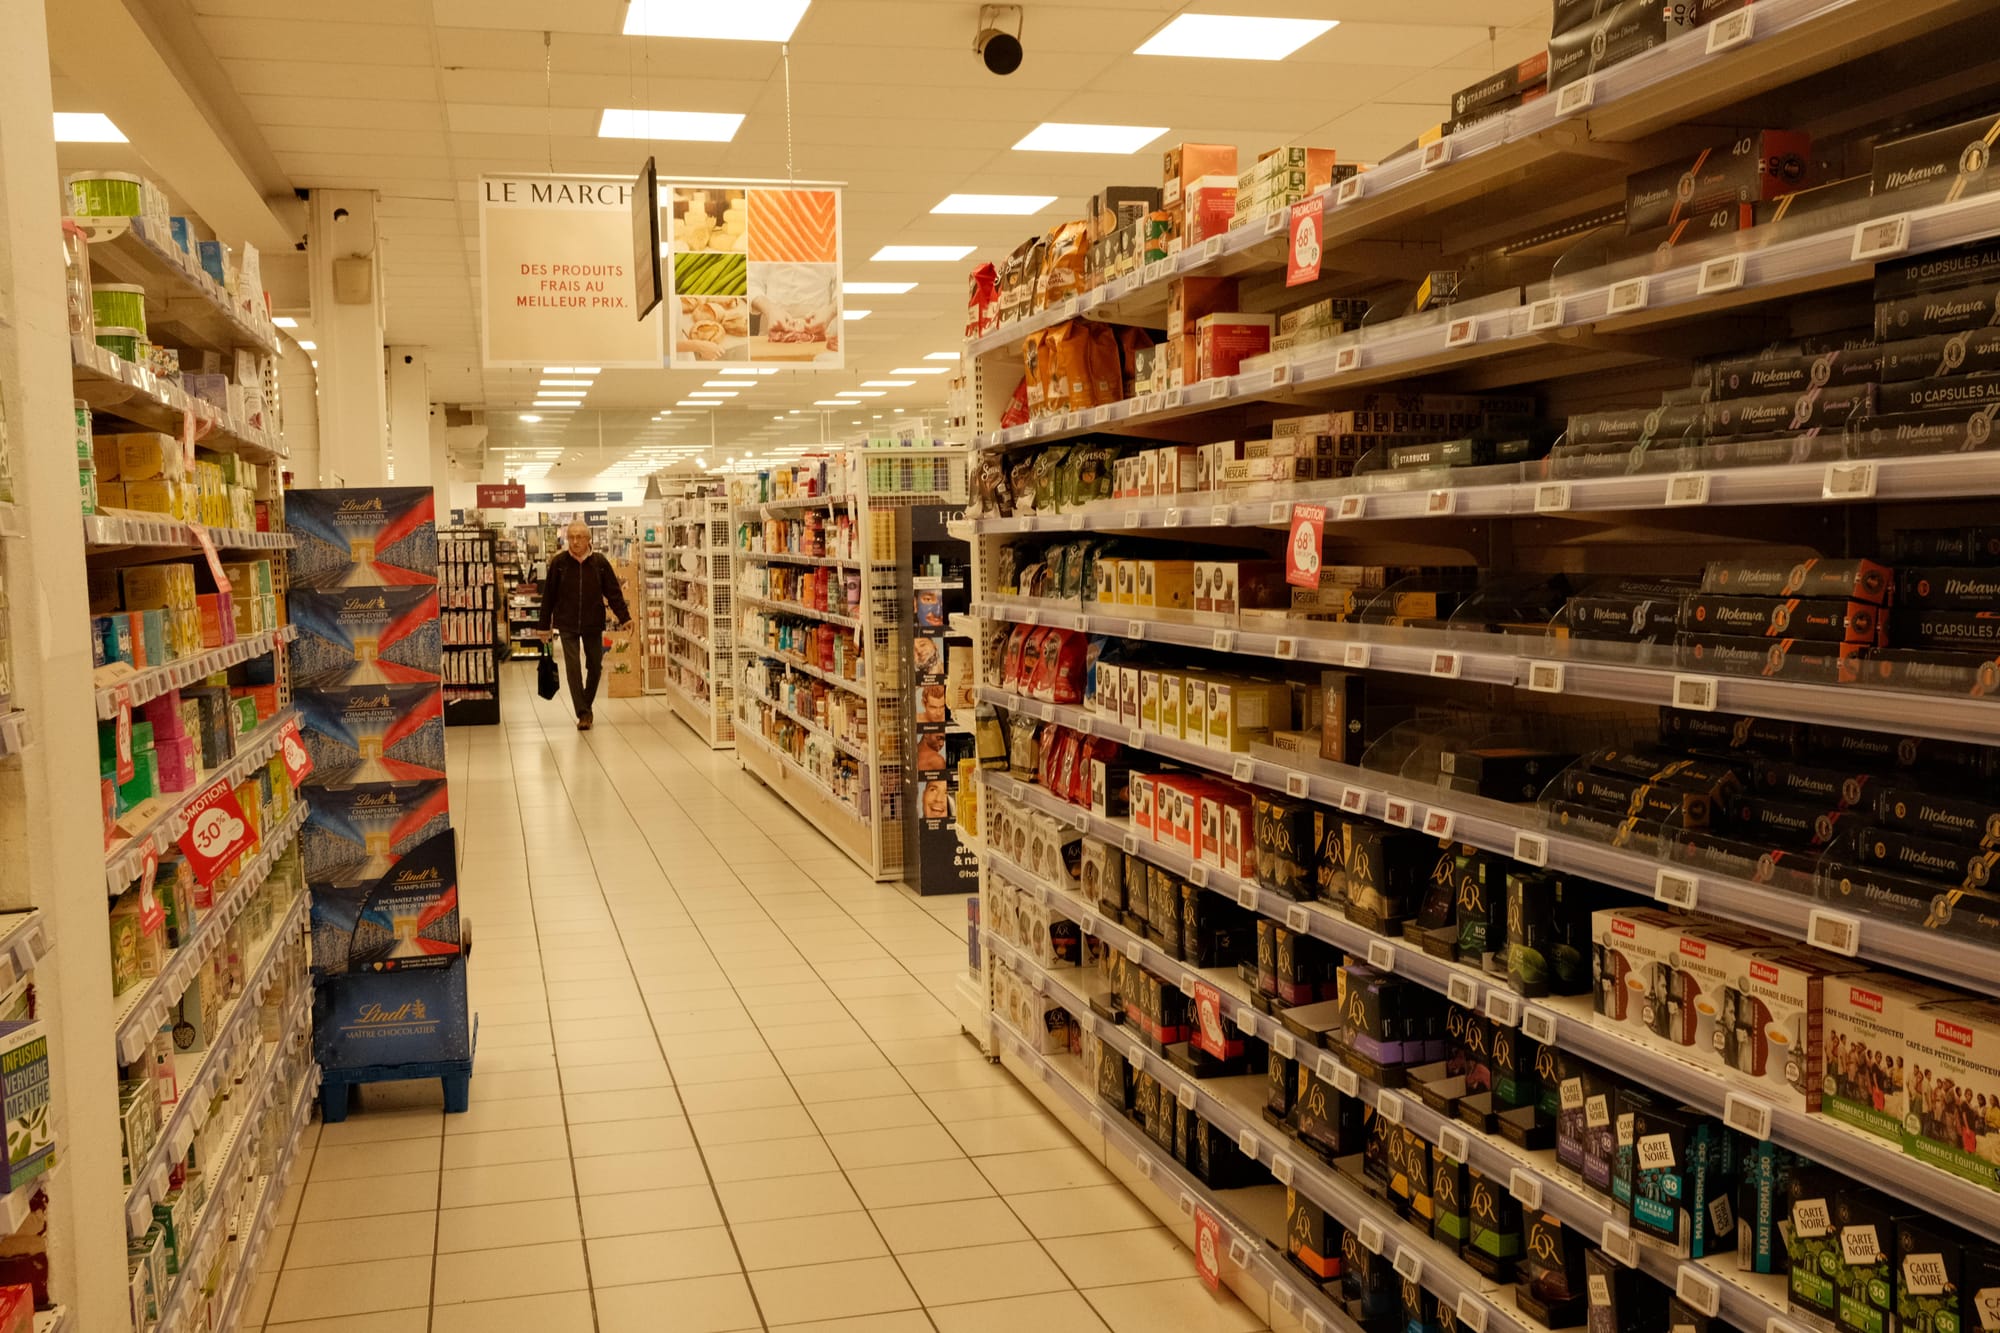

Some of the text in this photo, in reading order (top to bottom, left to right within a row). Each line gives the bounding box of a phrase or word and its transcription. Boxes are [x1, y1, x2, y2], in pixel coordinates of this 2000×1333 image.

[1466, 80, 1506, 105] STARBUCKS
[1732, 137, 1751, 155] 40
[1885, 164, 1944, 190] Mokawa
[486, 181, 517, 203] LE
[1633, 188, 1669, 209] Mokawa
[1292, 199, 1323, 219] PROMOTION
[1709, 210, 1728, 229] 40
[520, 264, 623, 277] DES PRODUITS
[1906, 267, 1918, 280] 10
[1920, 254, 1979, 278] CAPSULES
[540, 280, 604, 292] FRAIS AU
[516, 295, 629, 308] MEILLEUR PRIX.
[1924, 300, 1985, 321] Mokawa
[1752, 369, 1800, 385] Mokawa
[1910, 391, 1922, 404] 10
[1924, 384, 1984, 402] CAPSULES
[1742, 405, 1786, 421] Mokawa
[1599, 420, 1637, 433] Mokawa
[1896, 422, 1956, 440] Mokawa
[1399, 452, 1430, 465] STARBUCKS
[339, 498, 374, 511] Lindt
[1295, 506, 1324, 522] PROMOTION
[1739, 569, 1781, 583] Mokawa
[343, 597, 377, 610] Lindt
[1594, 607, 1627, 620] Mokawa
[1717, 606, 1763, 622] Mokawa
[1921, 623, 1994, 638] 10 CAPSULES
[1713, 644, 1760, 660] Mokawa
[347, 696, 382, 709] Lindt
[1689, 719, 1727, 734] Mokawa
[1841, 736, 1889, 753] Mokawa
[1787, 774, 1833, 792] Mokawa
[354, 793, 388, 806] Lindt
[1592, 784, 1626, 800] Mokawa
[1761, 809, 1807, 829] Mokawa
[1920, 805, 1976, 828] Mokawa
[1900, 845, 1957, 870] Mokawa
[396, 869, 429, 882] Lindt
[1458, 875, 1486, 913] L'OR
[1865, 882, 1919, 907] Mokawa
[1681, 959, 1688, 968] LA
[1751, 963, 1778, 984] Malongo
[1751, 984, 1758, 992] LA
[1759, 985, 1779, 1001] GRANDE
[1851, 991, 1882, 1011] Malongo
[354, 1002, 411, 1024] Lindt
[1838, 1011, 1849, 1021] DES
[1849, 1014, 1868, 1029] PETITS
[9, 1029, 37, 1044] MONOPRIX
[377, 1026, 436, 1037] CHOCOLATIER
[1936, 1022, 1972, 1045] Malongo
[2, 1038, 47, 1072] INFUSION
[1906, 1040, 1921, 1051] CAFÉ
[1921, 1043, 1933, 1055] DES
[1934, 1048, 1956, 1063] PETITS
[4, 1060, 49, 1095] VERVEINE
[1562, 1084, 1579, 1095] CARTE
[1564, 1092, 1580, 1103] NOIRE
[6, 1084, 50, 1117] MENTHE
[1588, 1102, 1604, 1112] CARTE
[1589, 1110, 1606, 1121] NOIRE
[1832, 1098, 1864, 1121] COMMERCE
[1643, 1141, 1668, 1153] CARTE
[1916, 1138, 1953, 1163] COMMERCE
[1644, 1151, 1671, 1162] NOIRE
[1696, 1166, 1705, 1209] FORMAT
[1470, 1182, 1498, 1224] L'OR
[1760, 1179, 1770, 1224] FORMAT
[1798, 1207, 1825, 1219] CARTE
[1695, 1211, 1704, 1240] MAXI
[1800, 1217, 1826, 1230] NOIRE
[1528, 1223, 1563, 1266] L'OR
[1760, 1224, 1769, 1256] MAXI
[1846, 1233, 1873, 1246] CARTE
[1848, 1243, 1876, 1256] NOIRE
[1910, 1262, 1940, 1275] CARTE
[1912, 1273, 1943, 1286] NOIRE
